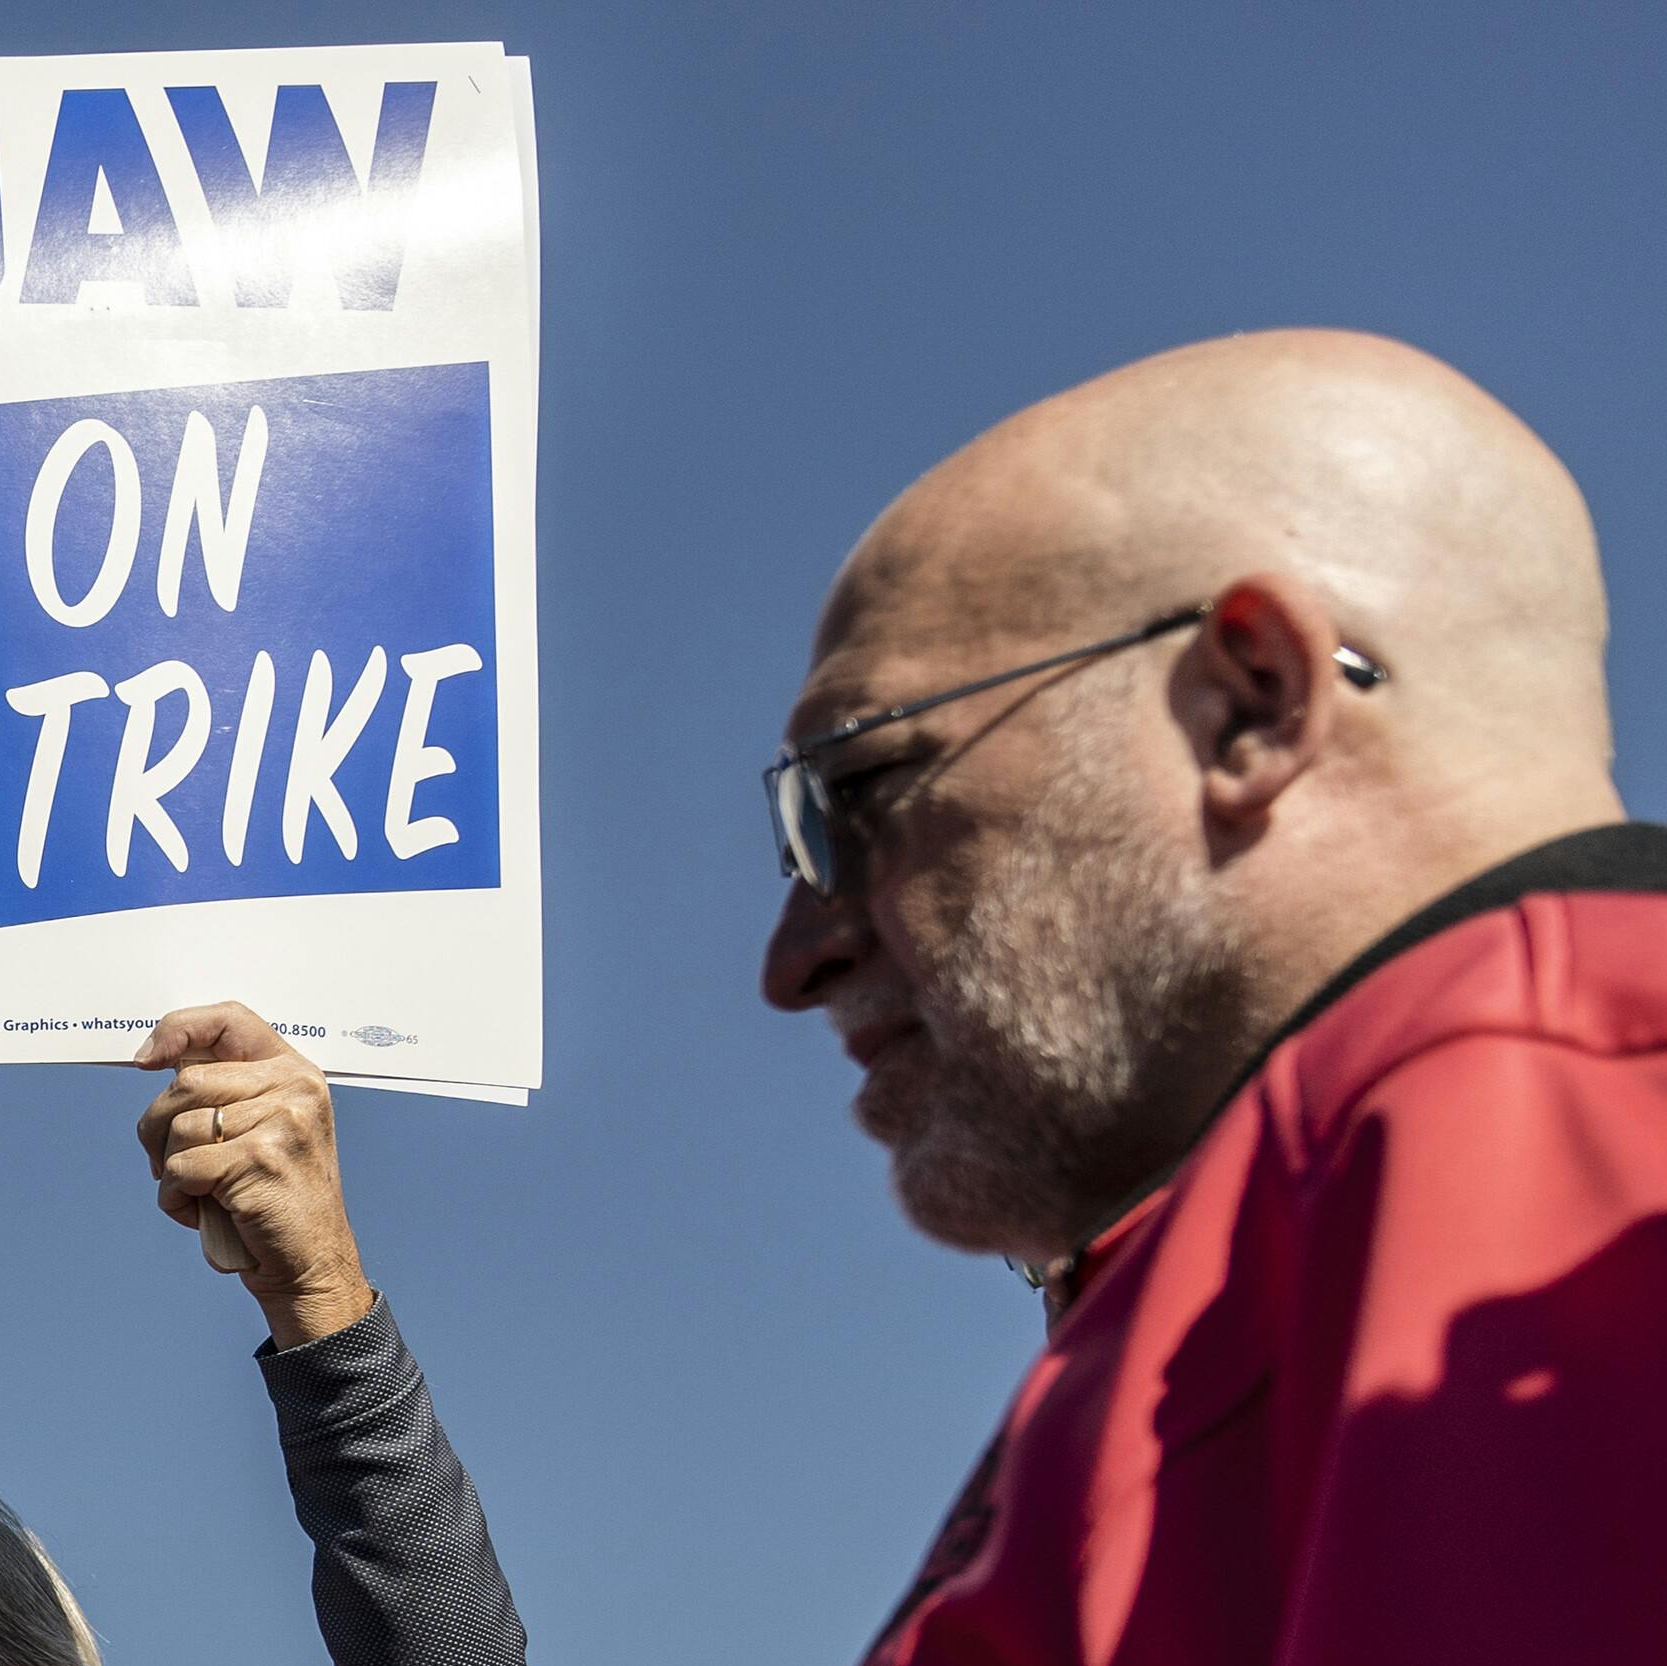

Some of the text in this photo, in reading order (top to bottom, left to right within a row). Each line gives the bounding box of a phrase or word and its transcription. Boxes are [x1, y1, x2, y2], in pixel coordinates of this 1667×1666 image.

[24, 403, 269, 628] ON
[3, 1018, 69, 1034] Graphics
[267, 1022, 327, 1038] 90.8500
